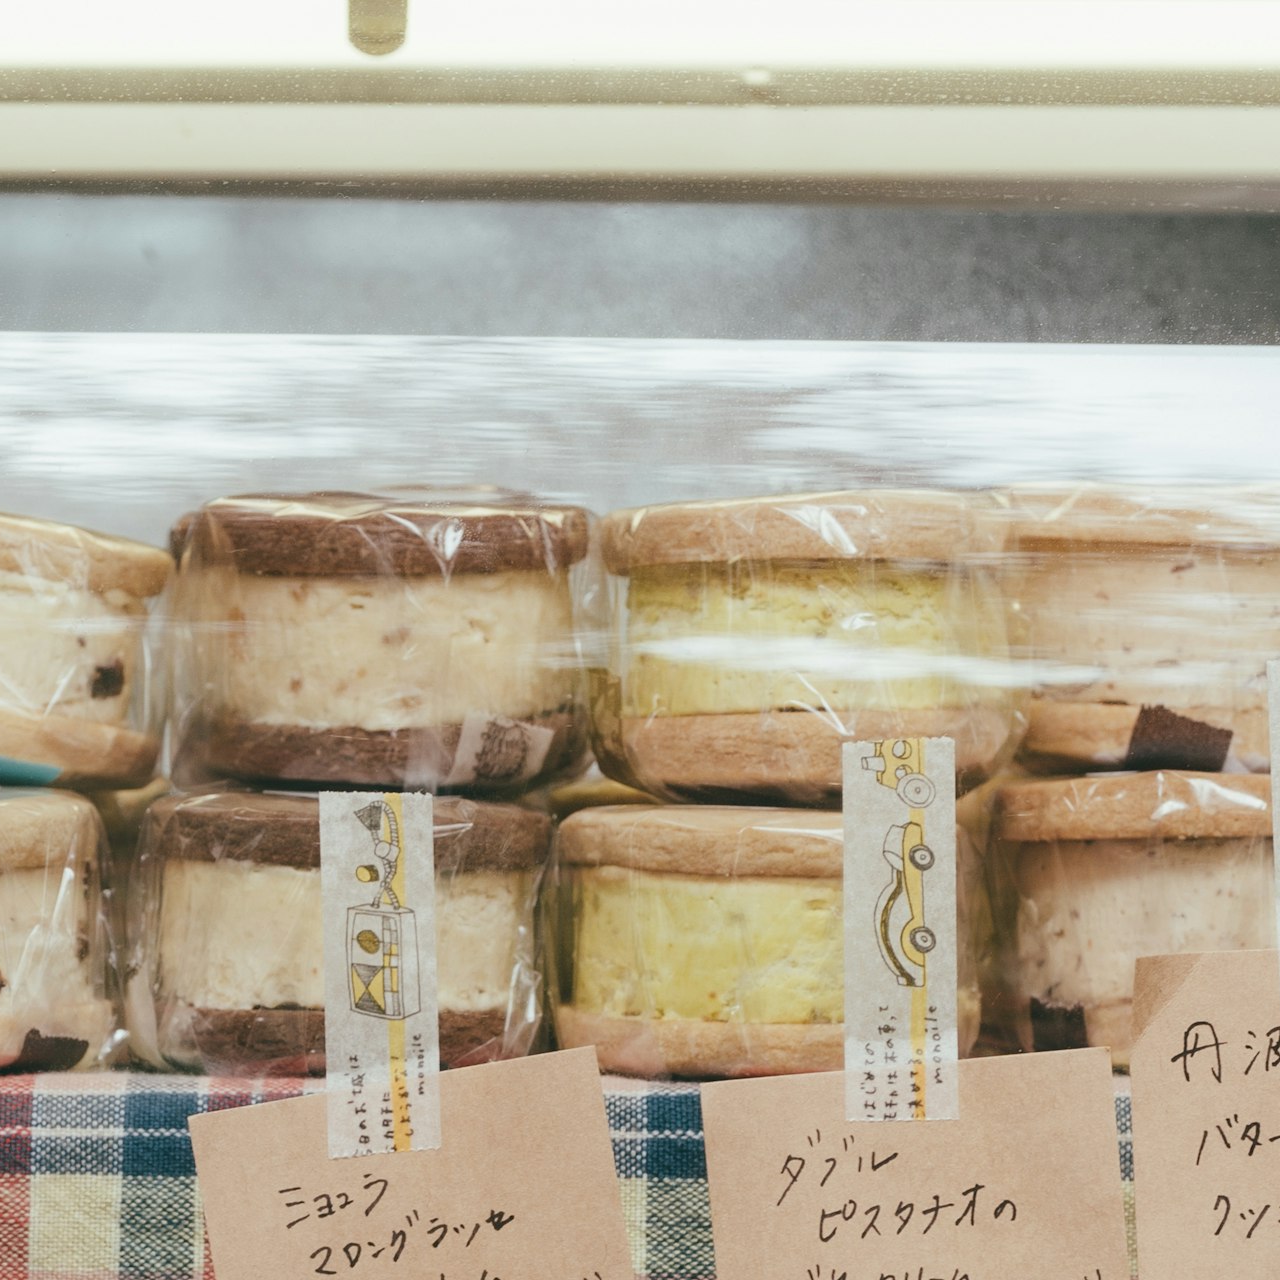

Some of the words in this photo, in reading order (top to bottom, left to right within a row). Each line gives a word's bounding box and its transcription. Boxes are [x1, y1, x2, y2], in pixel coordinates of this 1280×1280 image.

[924, 1004, 943, 1084] monoile
[860, 1042, 877, 1119] はじめての
[278, 1174, 388, 1229] ショコラ
[777, 1129, 898, 1205] ダブル
[310, 1210, 515, 1276] マロングラッセ
[819, 1183, 1017, 1242] ピスタチオの
